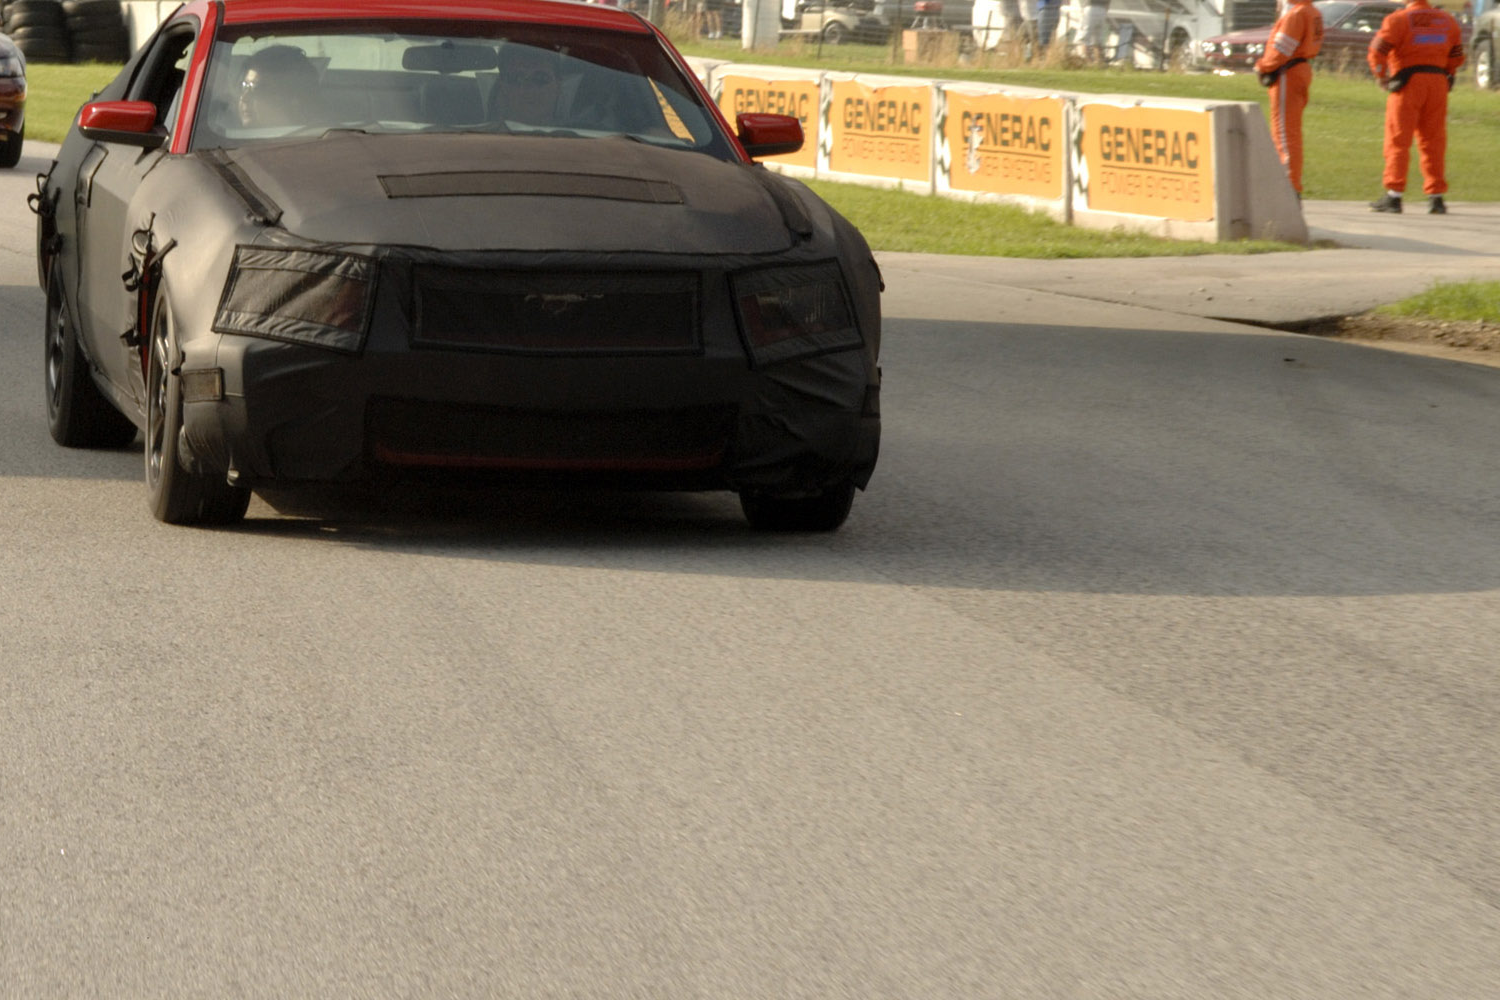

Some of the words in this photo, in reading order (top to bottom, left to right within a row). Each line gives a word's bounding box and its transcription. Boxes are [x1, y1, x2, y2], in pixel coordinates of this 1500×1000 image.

[843, 97, 922, 134] GENERAC
[842, 137, 875, 160] POWER
[877, 141, 921, 165] SYSTEMS
[1101, 124, 1199, 169] GENERAC
[1002, 156, 1051, 184] SYSTEMS
[1101, 171, 1142, 196] POWER
[1146, 175, 1200, 204] SYSTEMS
